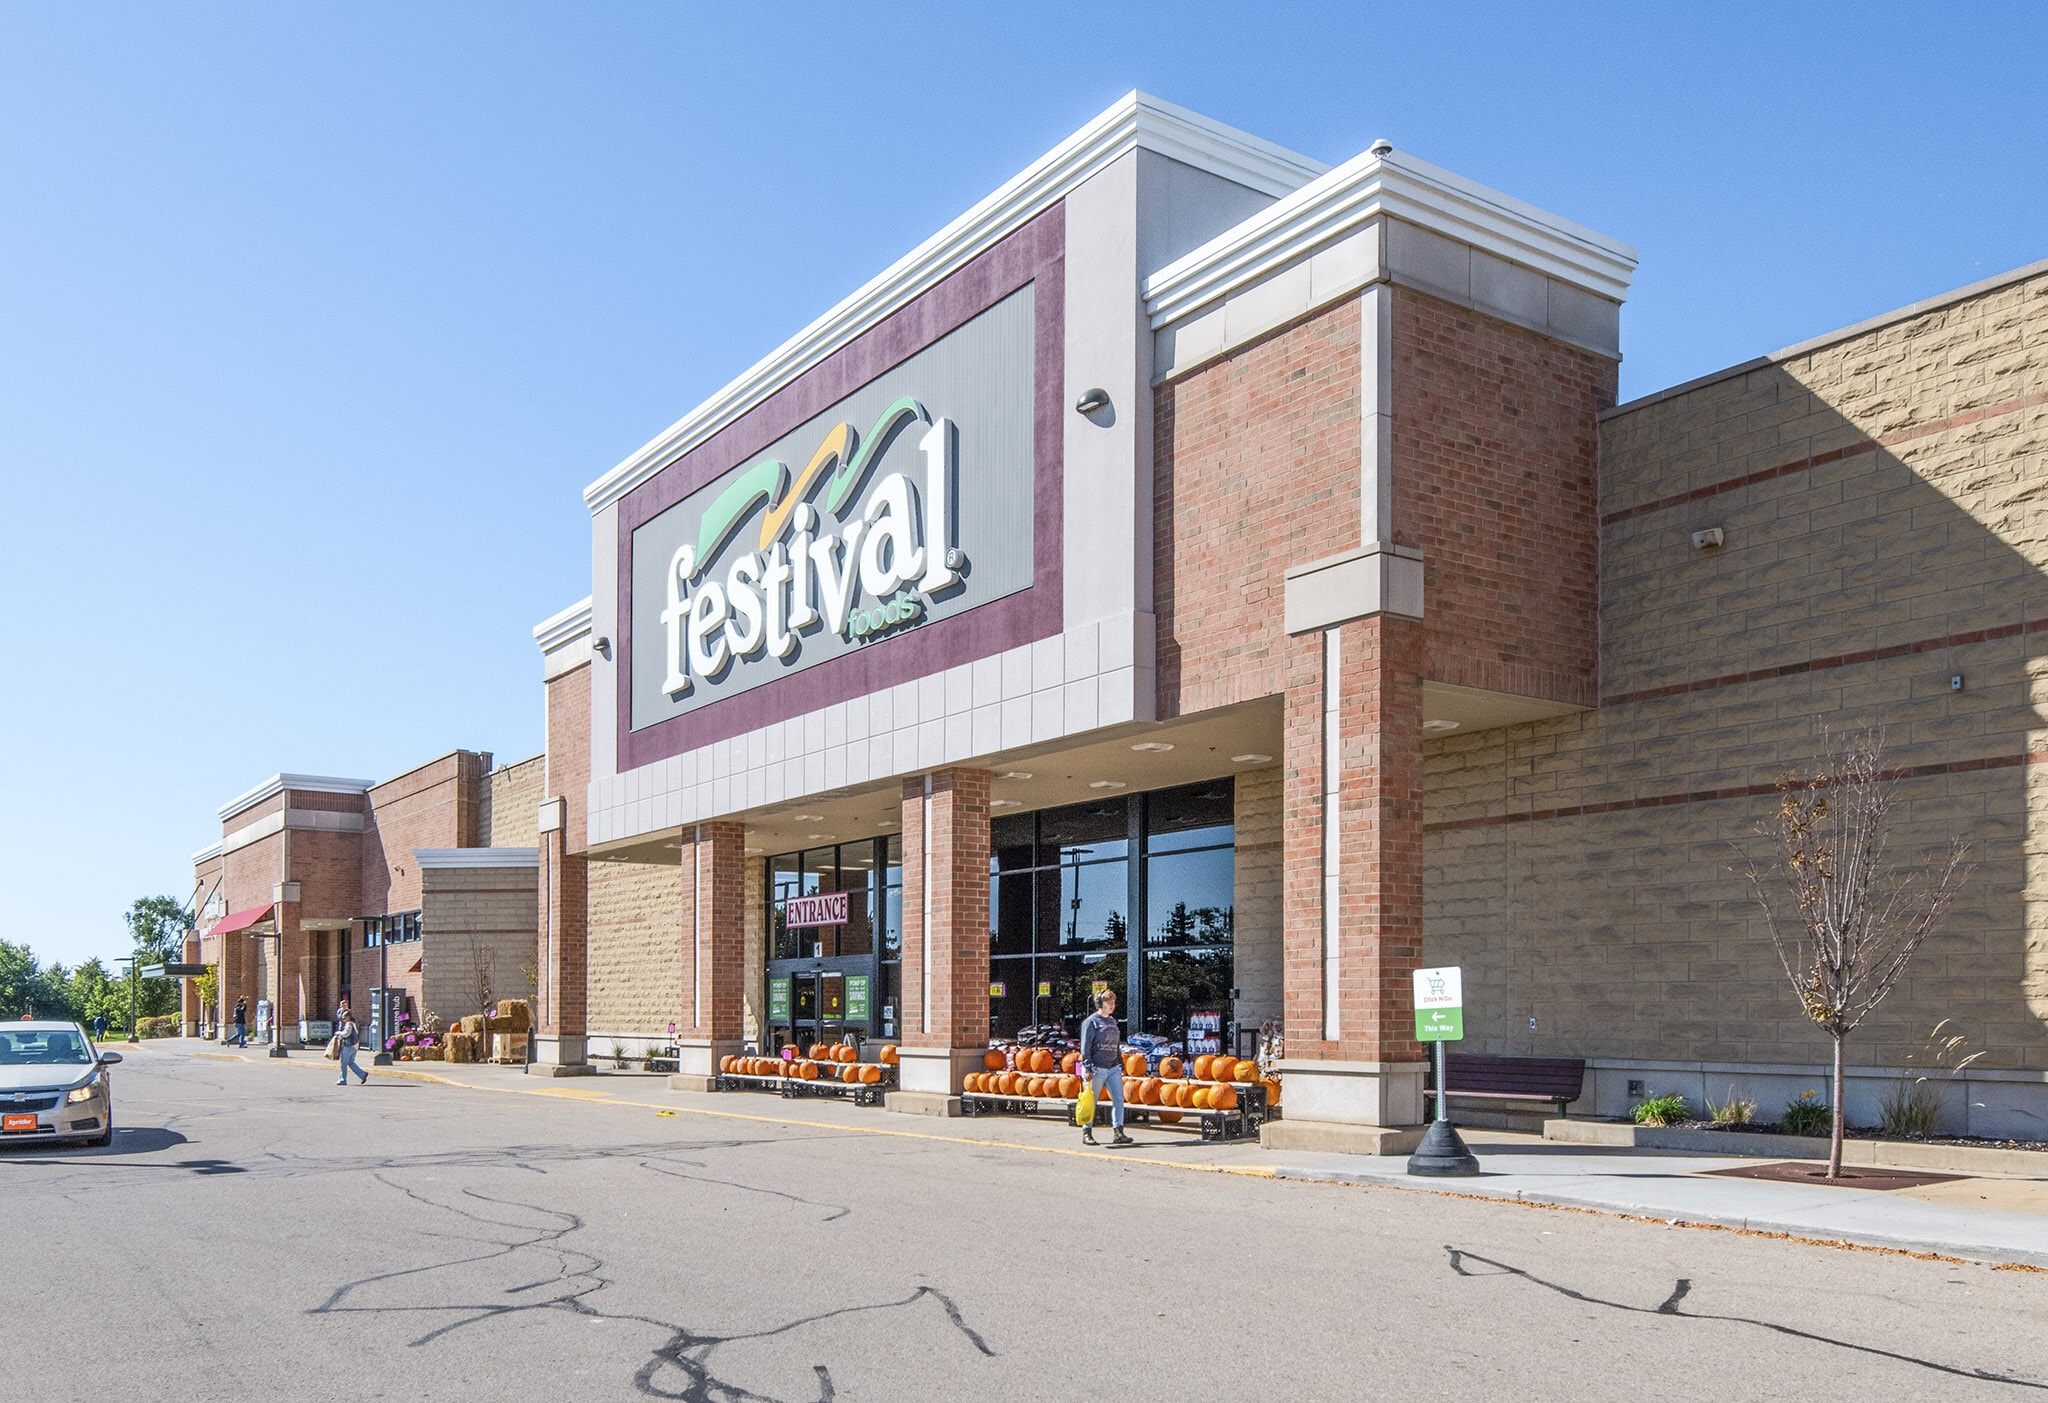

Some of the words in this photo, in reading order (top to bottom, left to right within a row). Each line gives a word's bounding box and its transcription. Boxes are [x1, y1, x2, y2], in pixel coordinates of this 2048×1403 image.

[660, 417, 959, 694] festival
[848, 592, 916, 638] foods
[788, 896, 846, 924] ENTRANCE
[815, 944, 820, 955] 1
